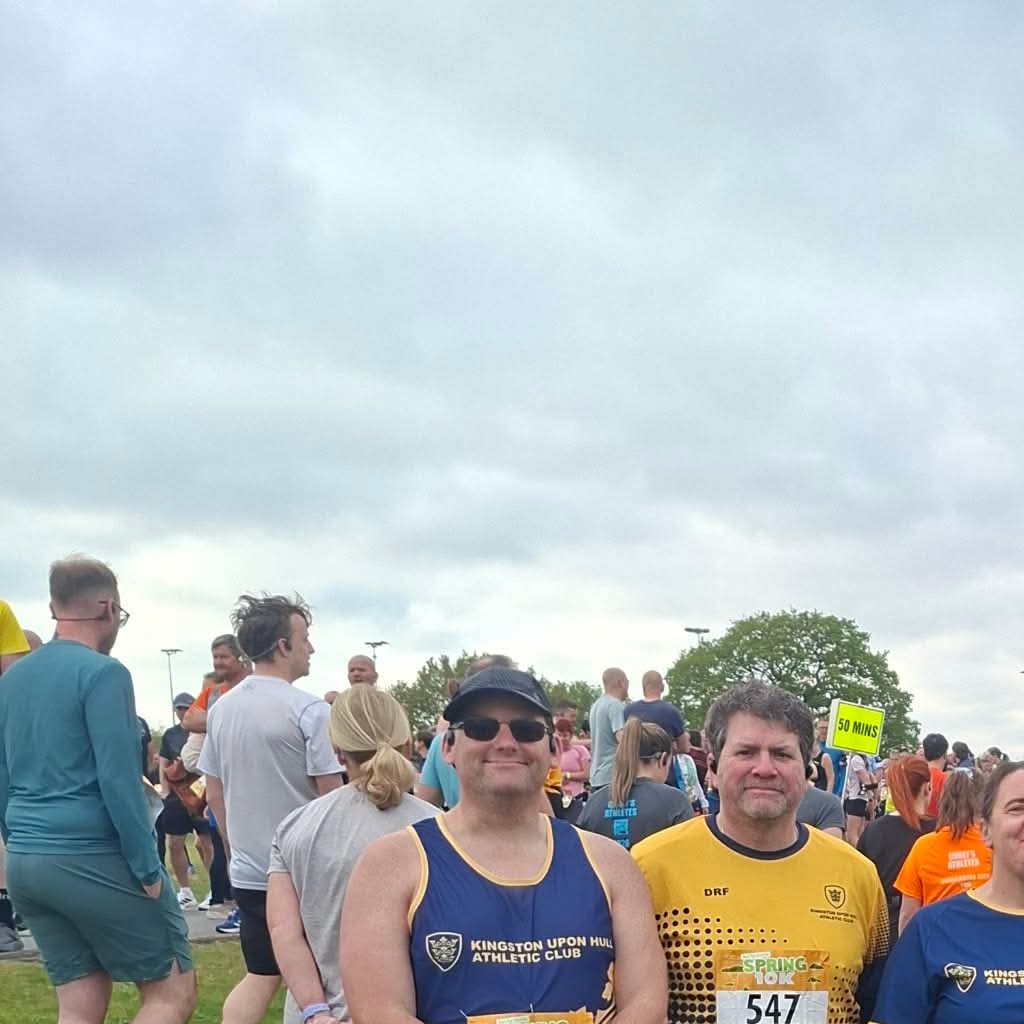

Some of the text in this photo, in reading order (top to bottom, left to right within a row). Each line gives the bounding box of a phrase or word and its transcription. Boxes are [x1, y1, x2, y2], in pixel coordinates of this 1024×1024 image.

[838, 718, 878, 738] 50 MINS
[704, 887, 729, 896] DRF
[471, 940, 543, 953] KINGSTON
[547, 936, 587, 948] UPON
[472, 948, 582, 964] ATHLETIC CLUB
[742, 956, 807, 972] SPRING
[753, 971, 796, 985] 10K
[746, 993, 801, 1024] 547
